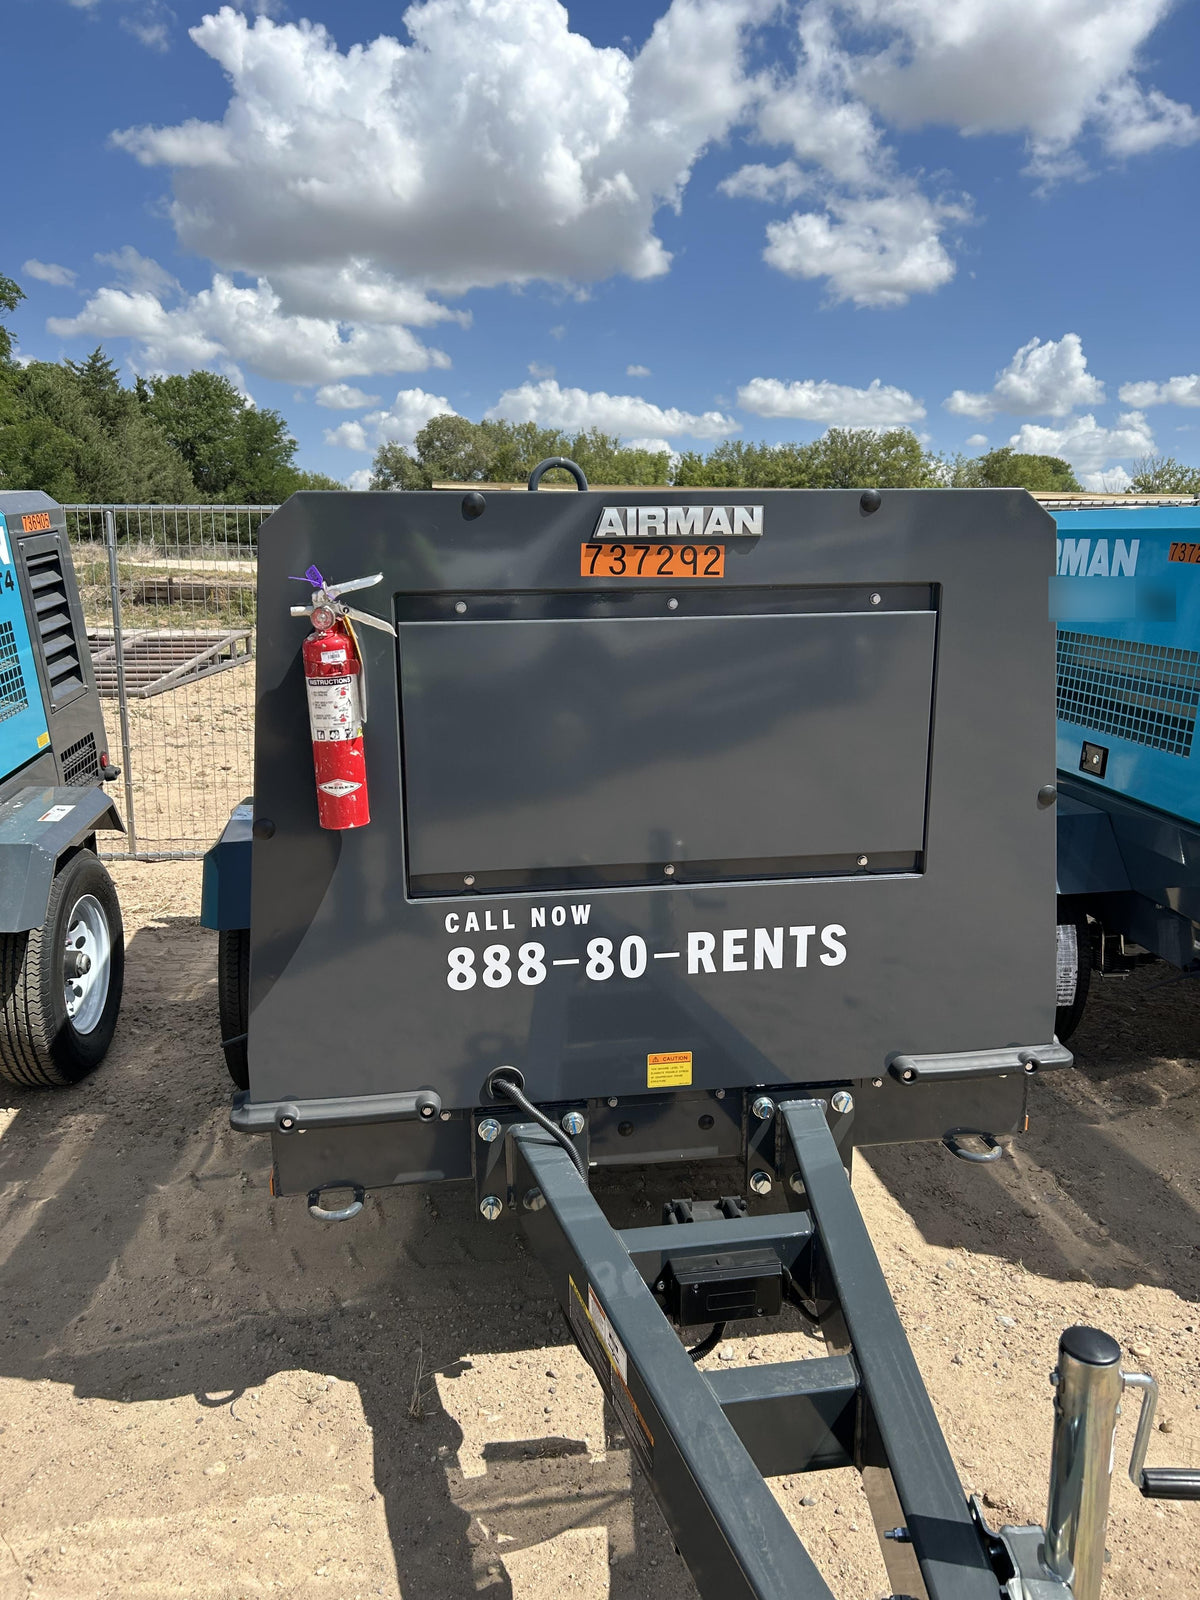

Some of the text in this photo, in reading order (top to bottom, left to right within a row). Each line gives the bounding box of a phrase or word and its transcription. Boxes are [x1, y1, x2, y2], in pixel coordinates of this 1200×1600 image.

[23, 513, 50, 532] 736905
[593, 506, 764, 537] AIRMAN
[585, 545, 721, 575] 737292
[309, 677, 351, 686] INSTRUCTIONS
[445, 904, 592, 933] CALL NOW
[447, 923, 848, 992] 888-80-RENTS
